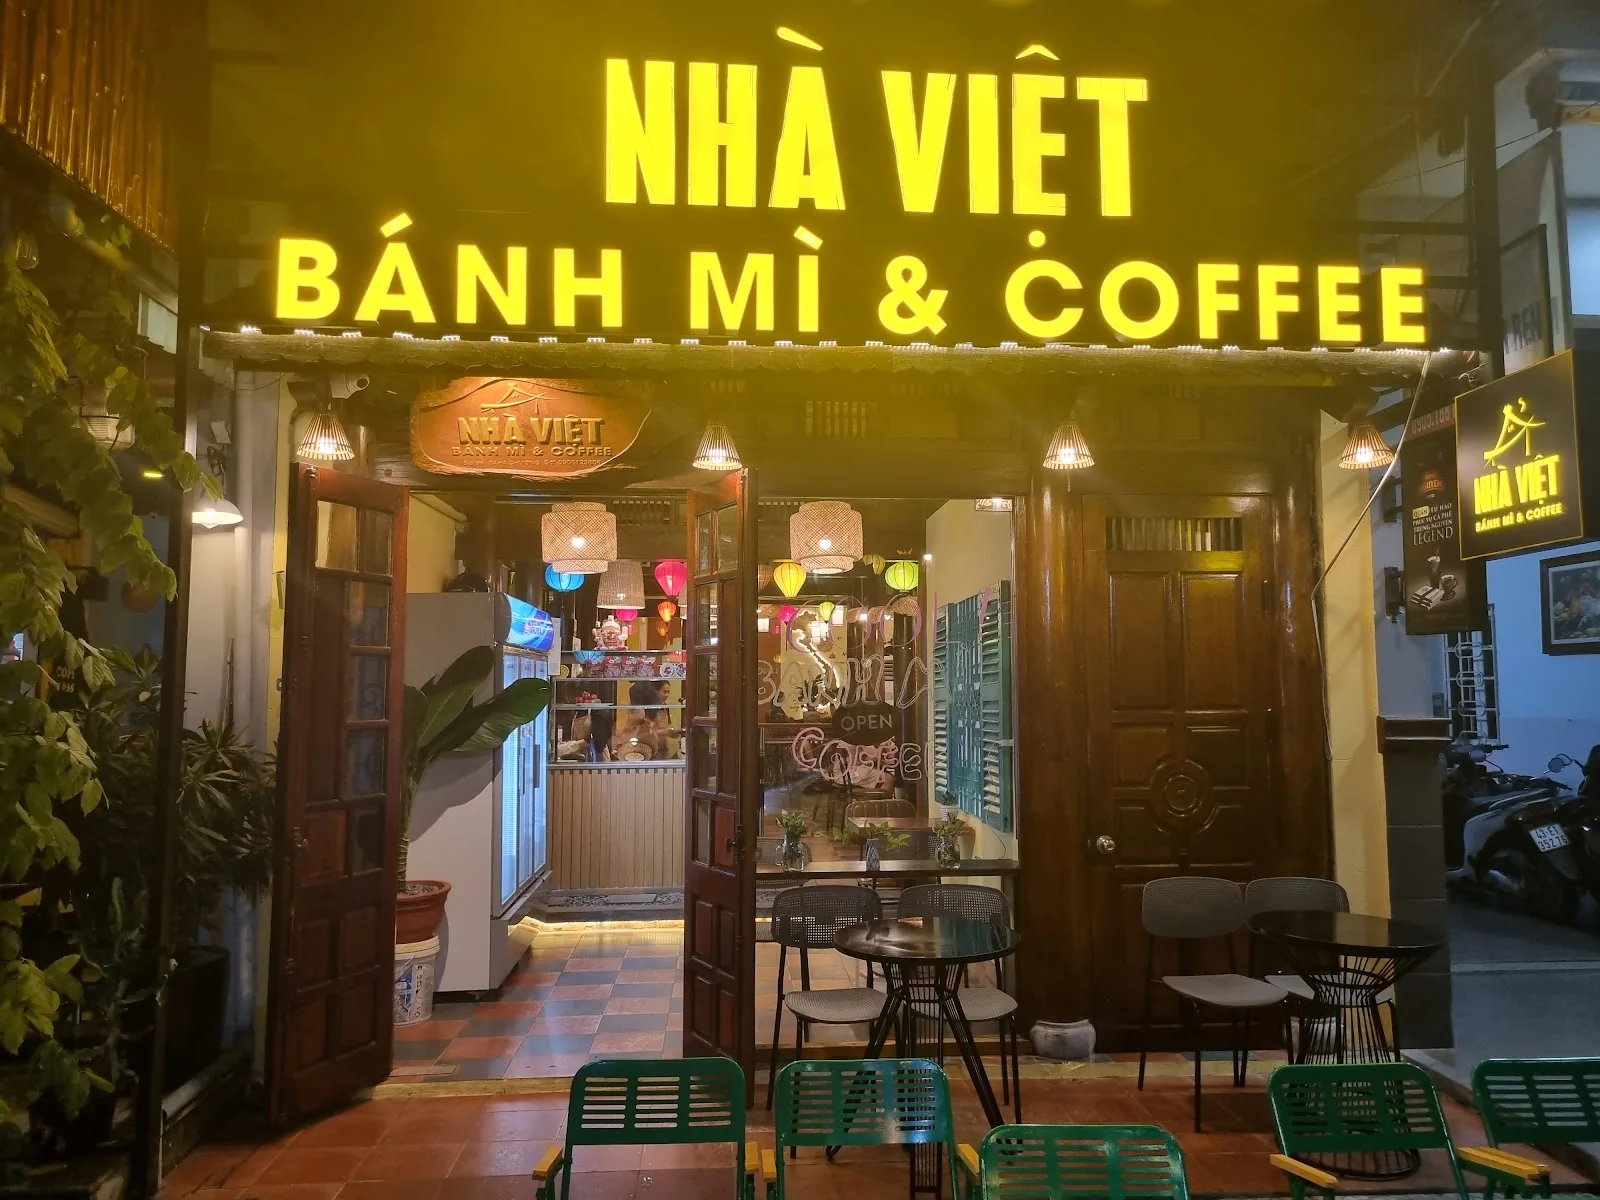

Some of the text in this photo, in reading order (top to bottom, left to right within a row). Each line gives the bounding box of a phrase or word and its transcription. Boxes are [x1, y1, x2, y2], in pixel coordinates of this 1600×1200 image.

[605, 26, 1148, 247] NHÀ VIỆT
[276, 212, 1425, 343] BÁNH MÌ & COFFEE
[458, 413, 606, 447] NHÀ VIỆT
[451, 444, 613, 457] BÁNH MÌ & COFFEE
[1474, 454, 1560, 515] NHÀ VIỆT
[1475, 503, 1563, 533] BÁNH MÌ & COFFEE
[1413, 526, 1454, 546] LEGEND
[840, 713, 893, 732] OPEN
[1535, 825, 1559, 839] 43-E1
